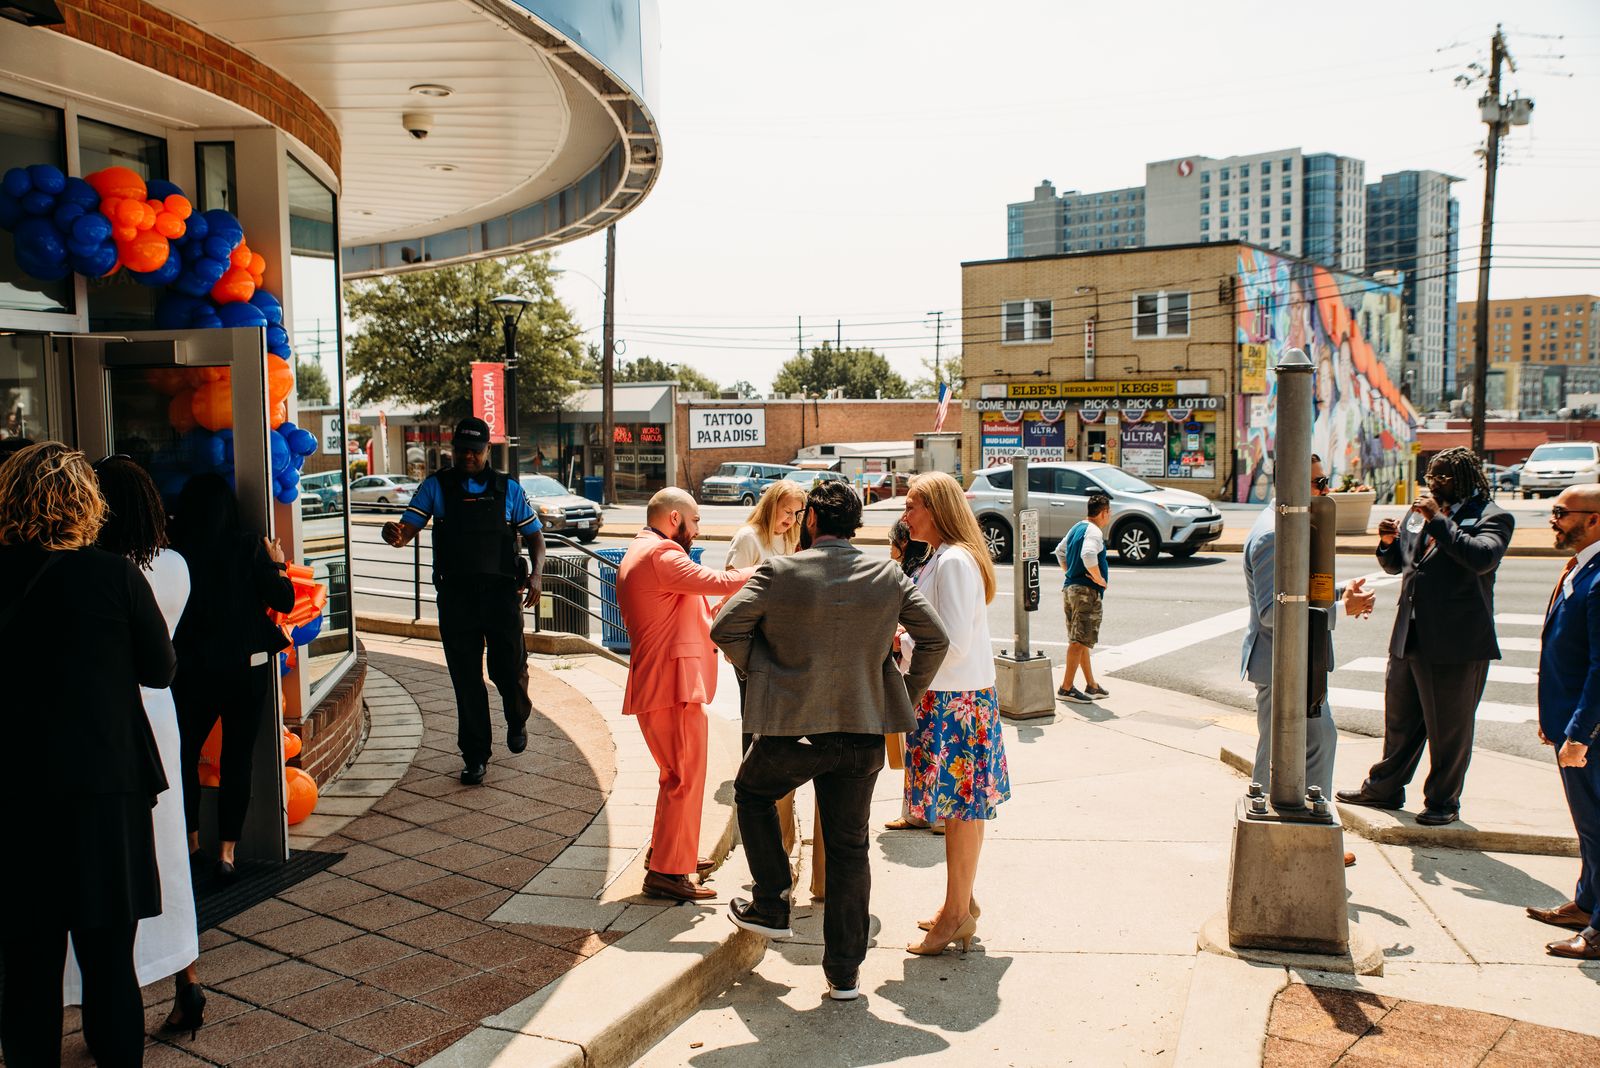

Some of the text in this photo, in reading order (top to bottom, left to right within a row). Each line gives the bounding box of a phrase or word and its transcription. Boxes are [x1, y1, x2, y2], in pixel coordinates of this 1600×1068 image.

[1012, 385, 1057, 395] ELBE'S
[1121, 383, 1159, 393] KEGS
[483, 372, 496, 436] WHEATON
[976, 398, 1217, 410] COME IN AND PLAY PICK 3 PICK 4 & LOTTO
[703, 413, 753, 426] TATTOO
[983, 424, 1020, 432] Budweiser
[640, 434, 662, 442] FAMOUS
[697, 429, 759, 443] PARADISE
[1122, 431, 1162, 442] ULTRA
